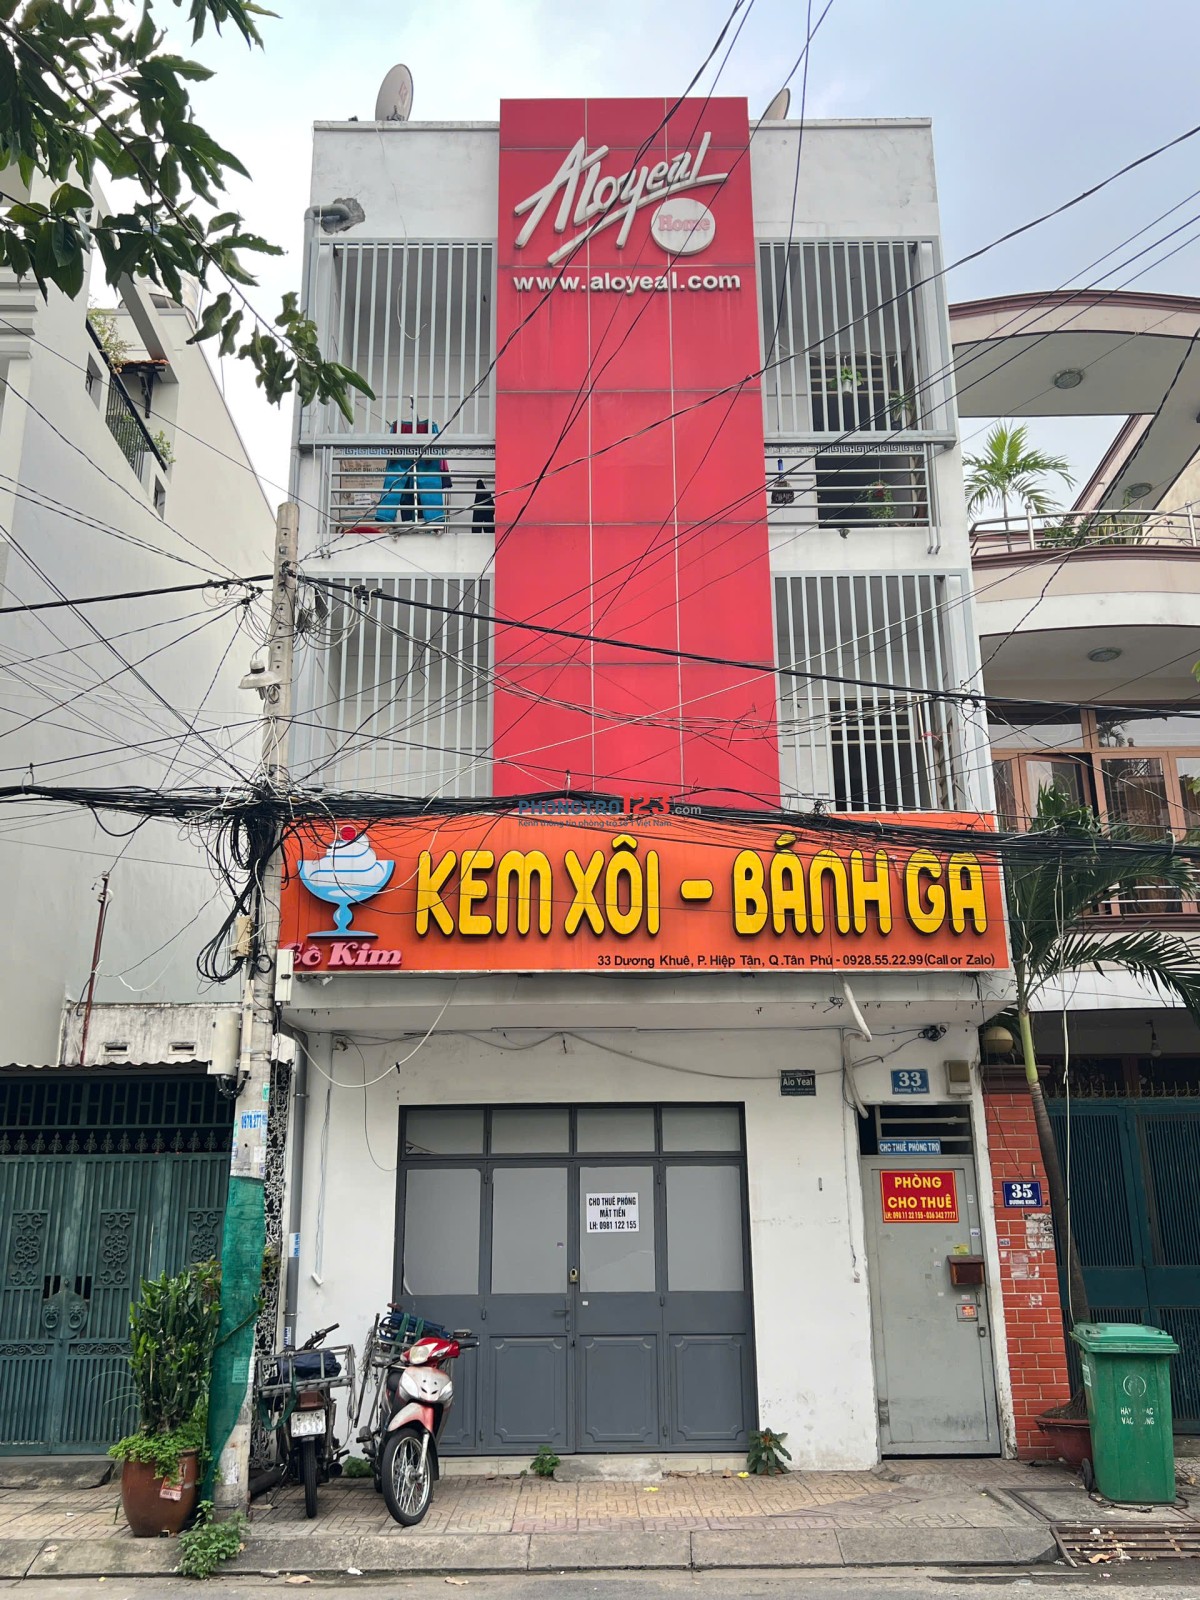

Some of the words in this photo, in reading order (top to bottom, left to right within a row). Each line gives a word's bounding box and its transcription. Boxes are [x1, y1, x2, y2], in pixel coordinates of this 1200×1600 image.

[658, 214, 711, 231] Home
[513, 272, 742, 295] www.aloyeal.com
[415, 850, 553, 936] KEM
[564, 834, 661, 936] XÔI
[680, 878, 714, 902] -
[733, 832, 893, 937] BÁNH
[328, 942, 402, 966] Kim
[598, 955, 612, 966] 33
[614, 955, 655, 968] Dương
[659, 954, 695, 968] Khuê,
[710, 955, 736, 968] Hiệp
[740, 954, 765, 967] Tân,
[810, 954, 833, 966] Phú
[950, 956, 962, 966] or
[966, 953, 995, 967] Zalo)
[899, 1071, 922, 1087] 33
[908, 1140, 928, 1152] PHÒNG
[894, 1173, 942, 1188] PHÒNG
[1011, 1183, 1033, 1198] 35
[589, 1197, 601, 1206] CHO
[602, 1196, 616, 1206] THUÊ
[617, 1195, 636, 1206] PHÒNG
[887, 1196, 918, 1208] CHO
[920, 1193, 952, 1208] THUÊ
[590, 1221, 599, 1230] LH:
[599, 1221, 613, 1230] 0981
[615, 1221, 625, 1229] 122
[626, 1220, 637, 1229] 155
